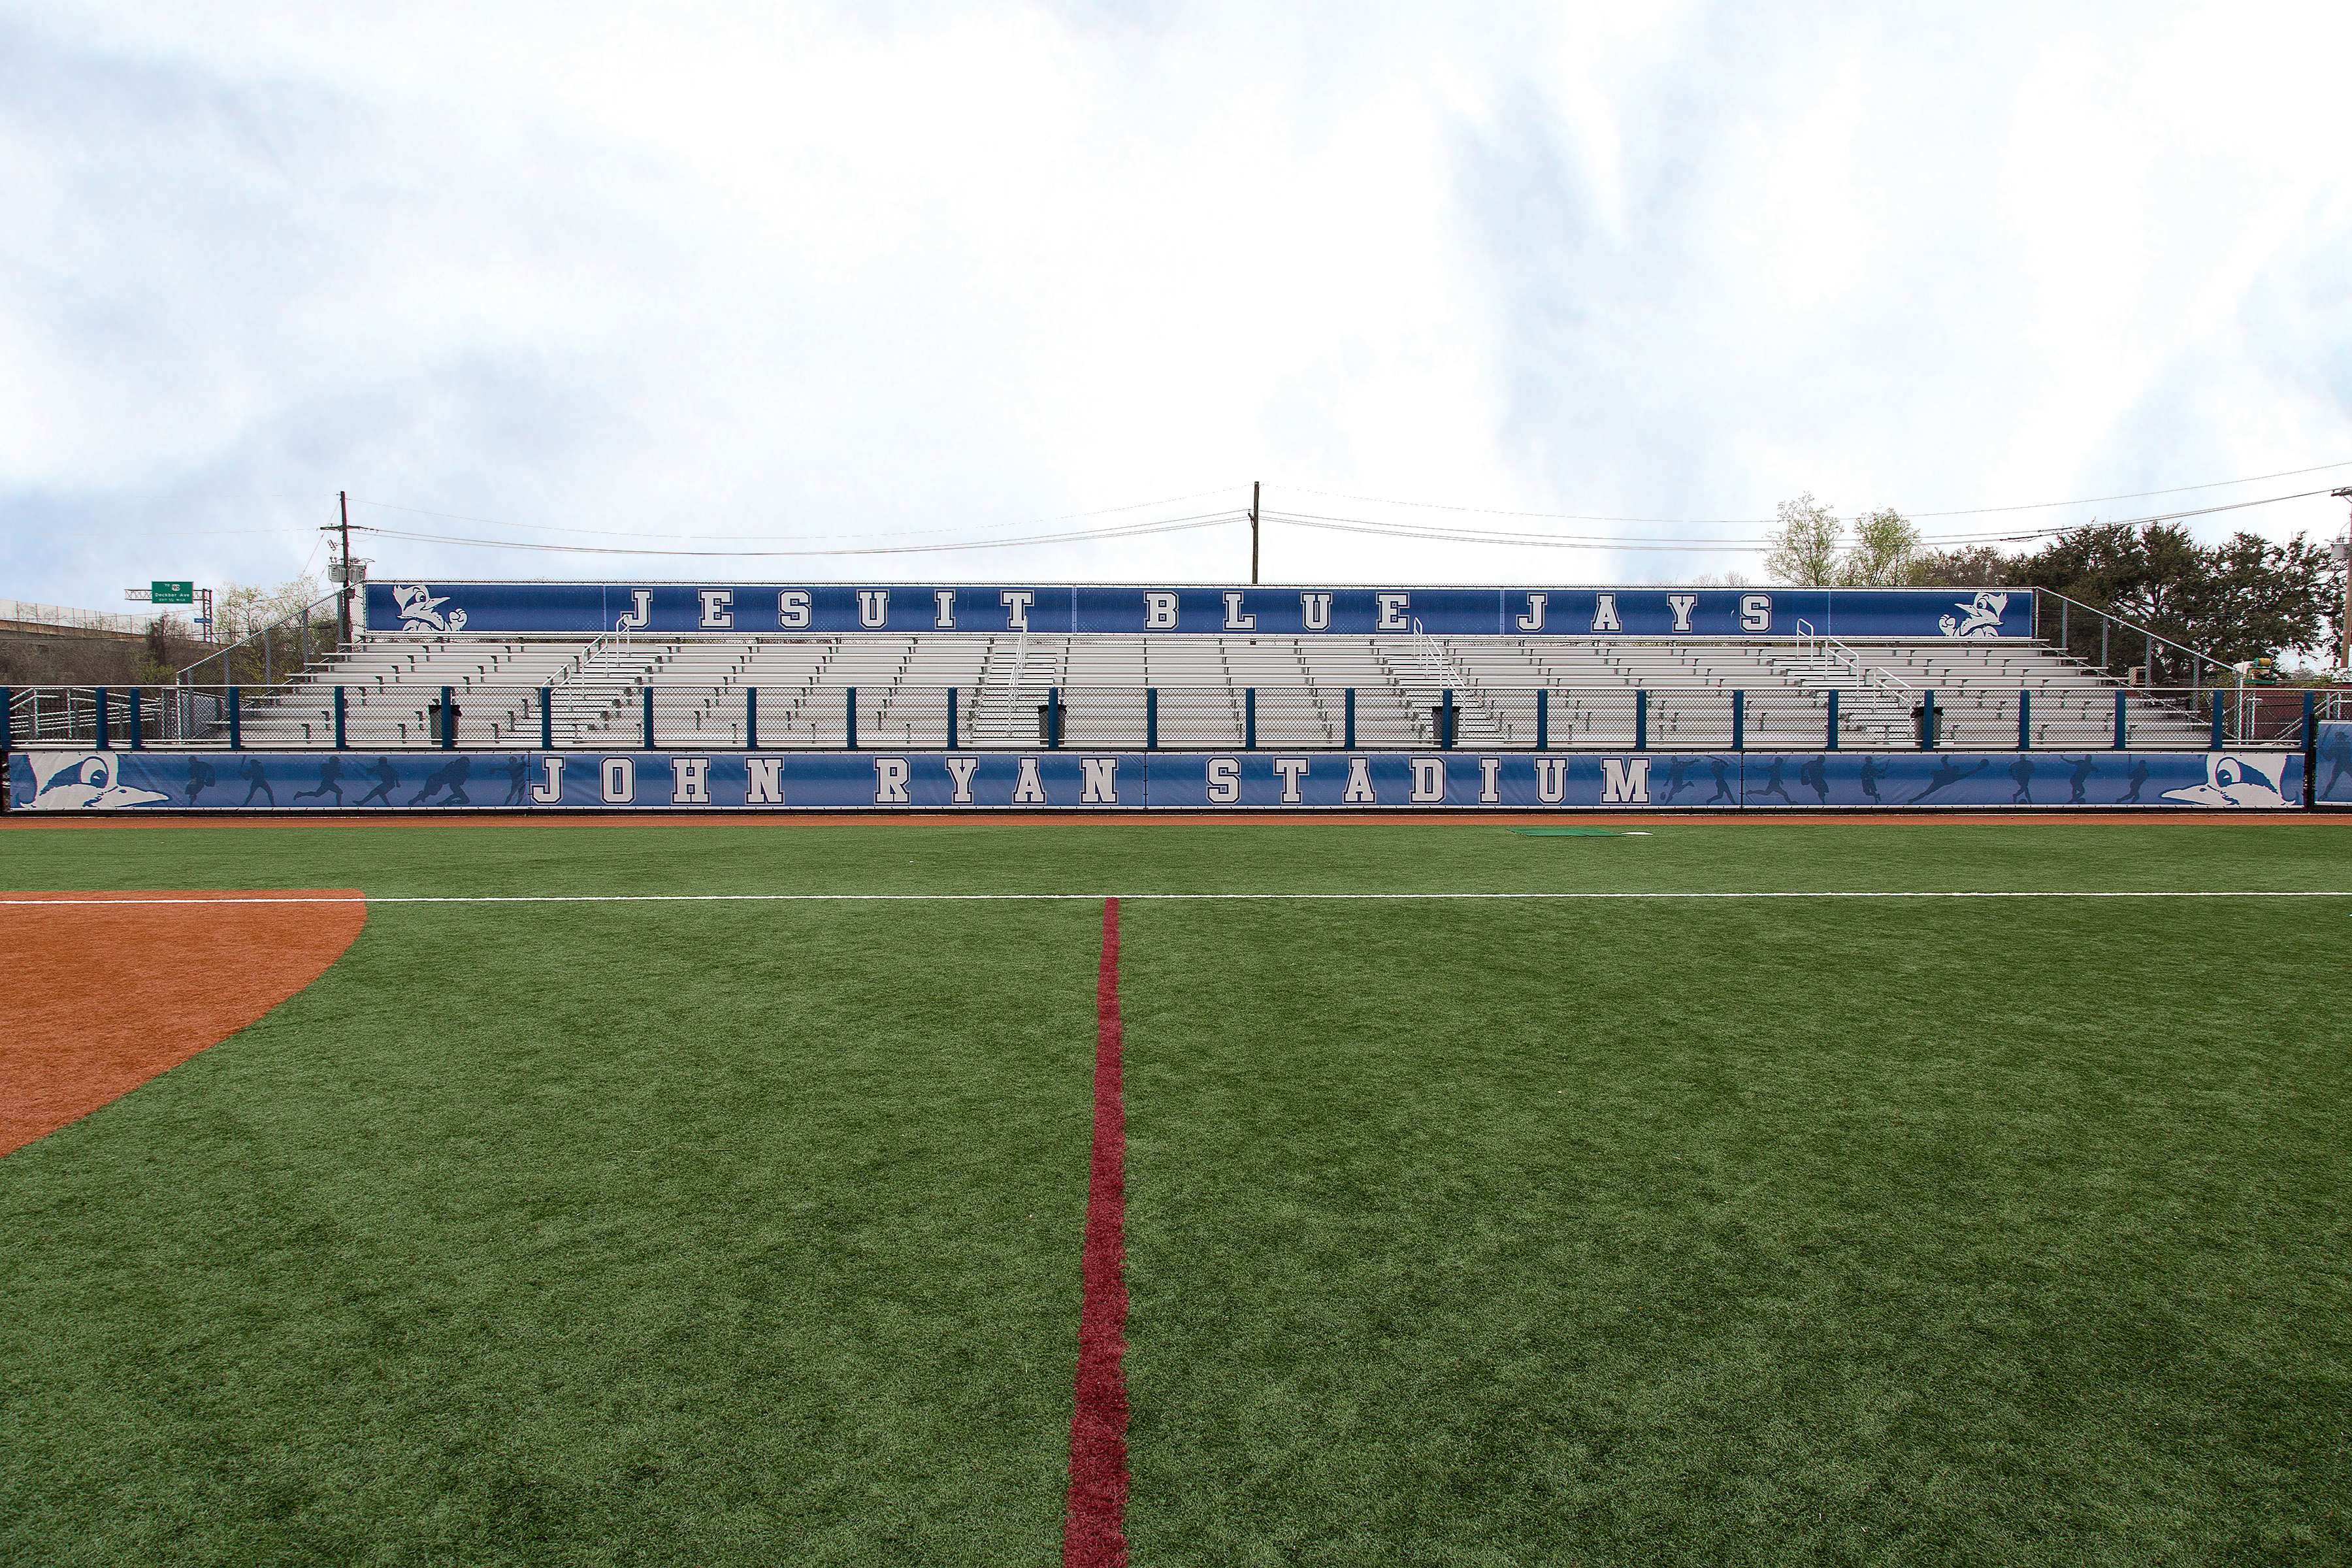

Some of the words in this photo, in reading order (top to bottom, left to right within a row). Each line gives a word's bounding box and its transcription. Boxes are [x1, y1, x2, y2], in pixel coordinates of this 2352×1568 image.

[620, 588, 1034, 630] JESUIT
[1143, 590, 1410, 632] BLUE
[1516, 592, 1772, 633] JAYS
[531, 756, 785, 805] JOHN
[874, 756, 1119, 805] RYAN
[1205, 756, 1651, 805] STADIUM
